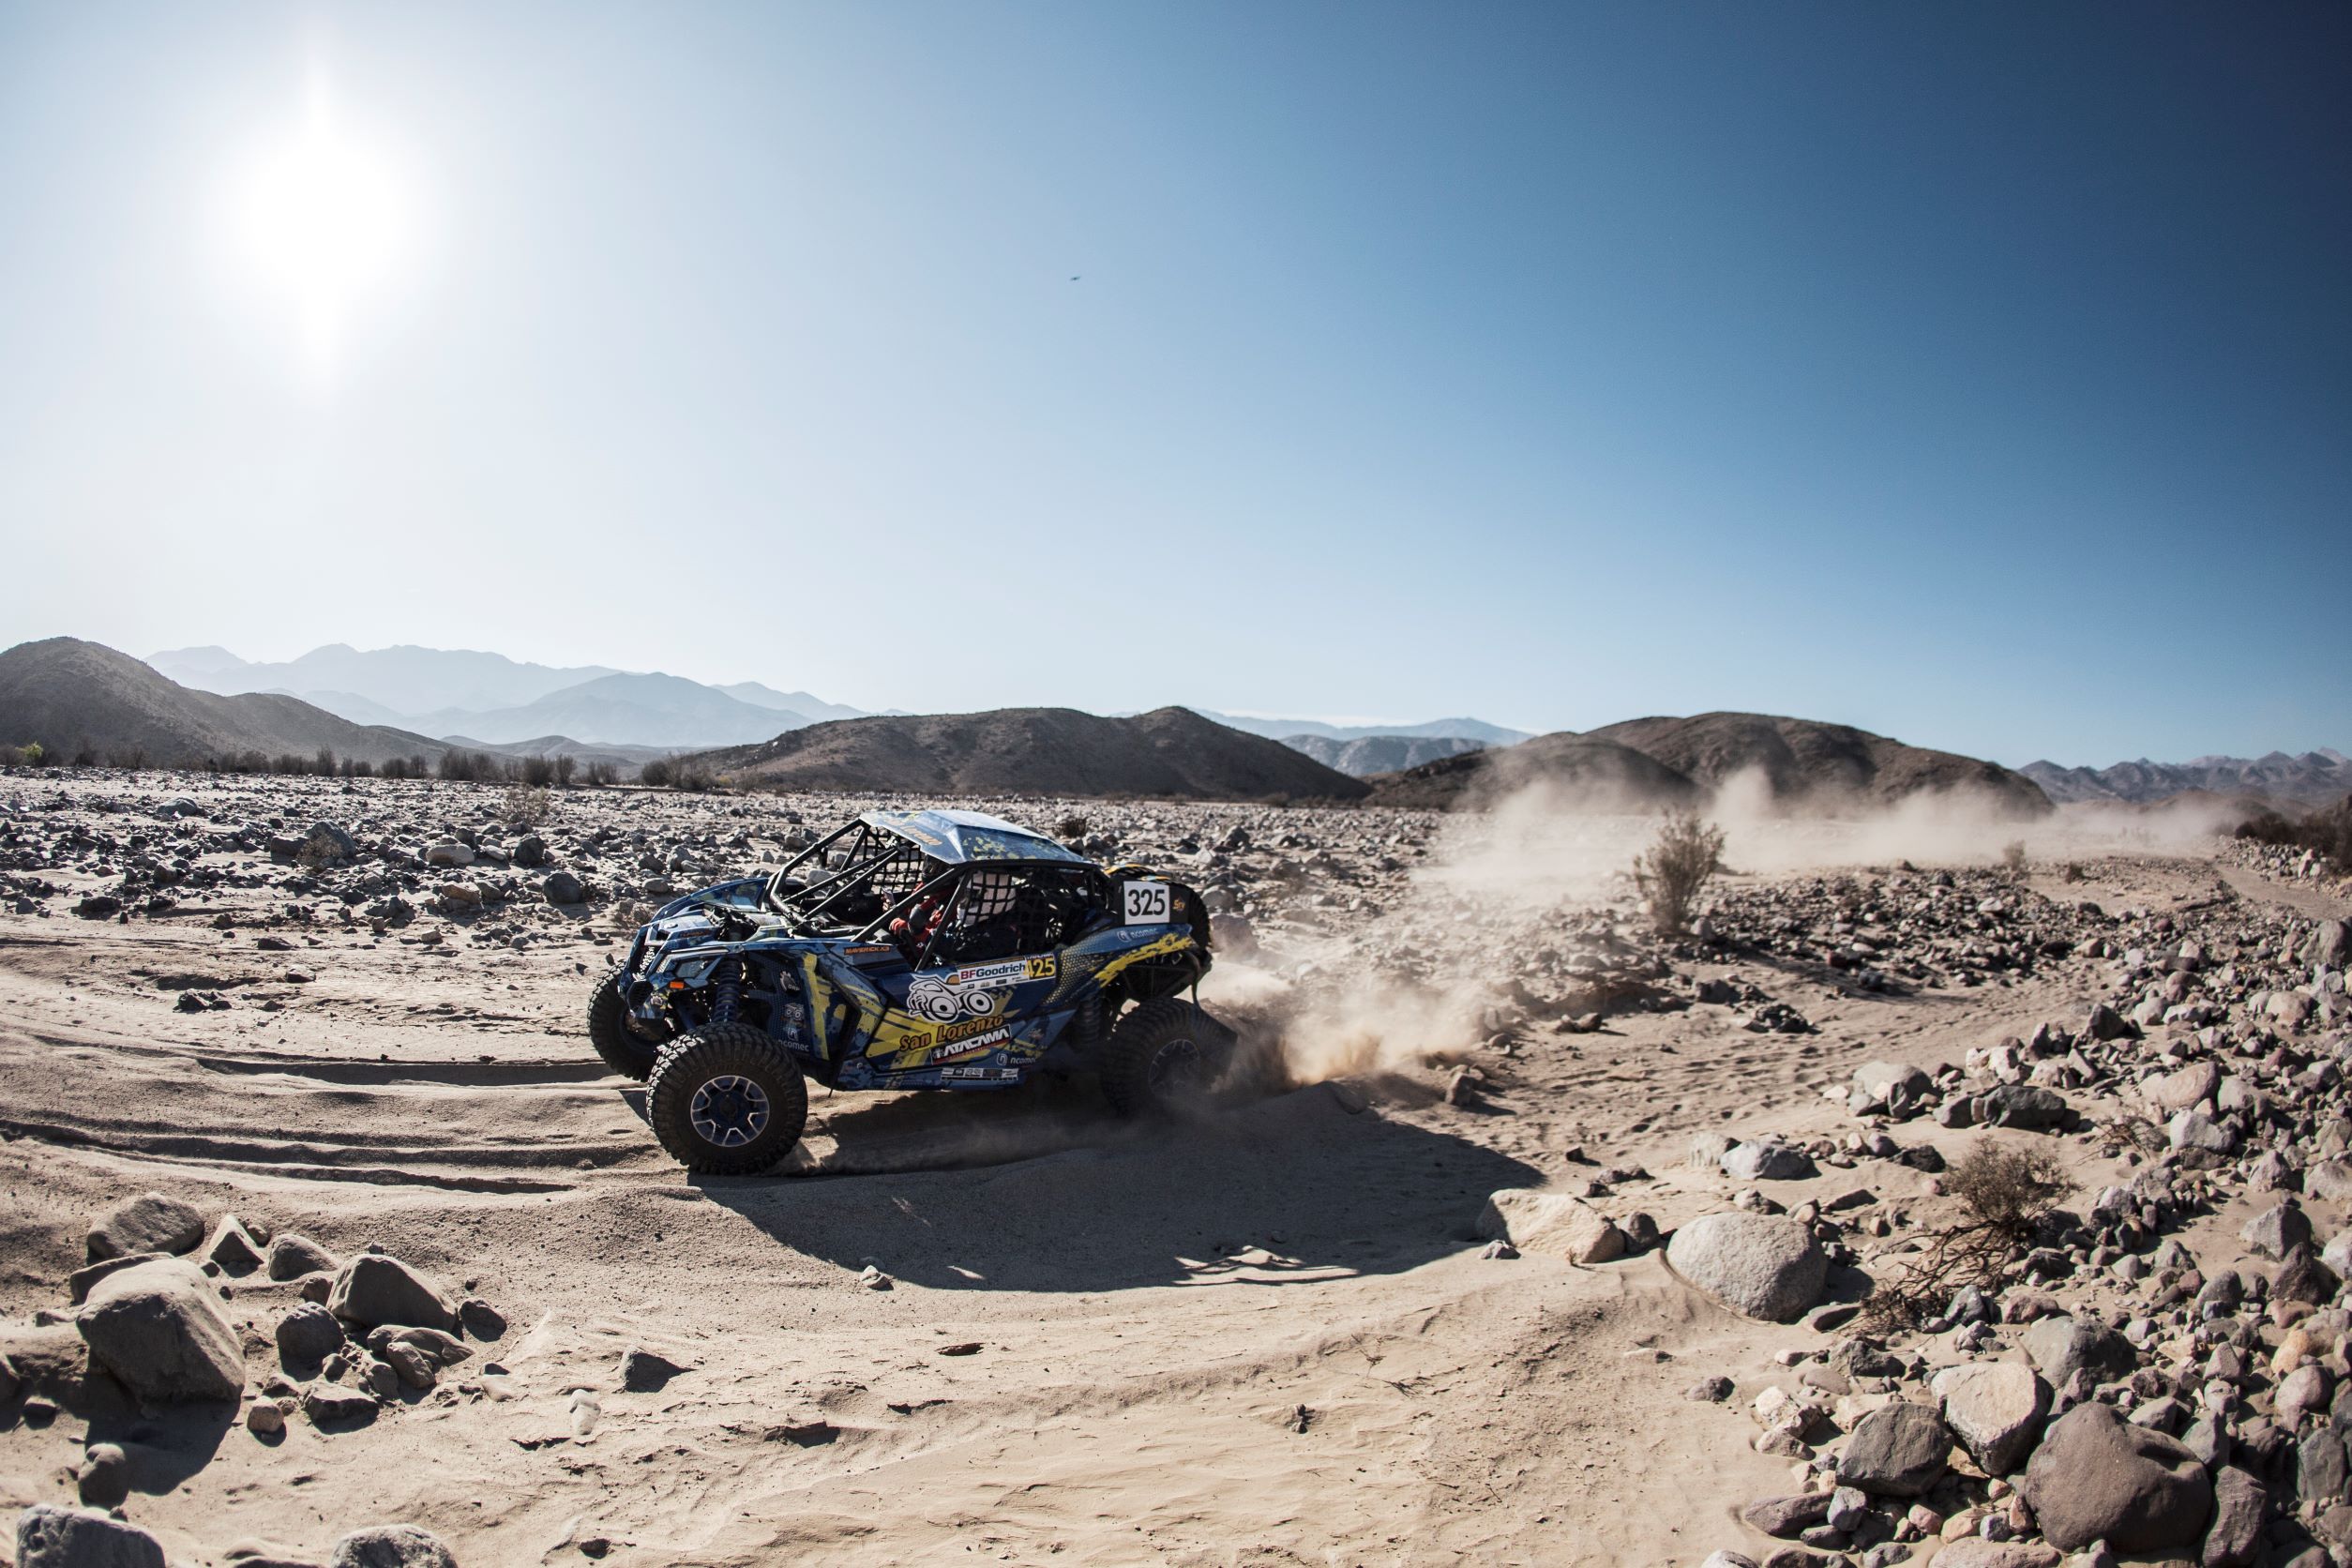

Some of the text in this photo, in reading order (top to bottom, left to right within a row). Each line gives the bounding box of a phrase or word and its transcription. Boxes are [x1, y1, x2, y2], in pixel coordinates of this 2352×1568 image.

[1128, 889, 1166, 916] 325
[960, 962, 1025, 980] BFGoodrich
[1023, 957, 1056, 977] 425
[899, 1014, 1005, 1051] San Lorenzo
[943, 1028, 1010, 1056] ATACAMA
